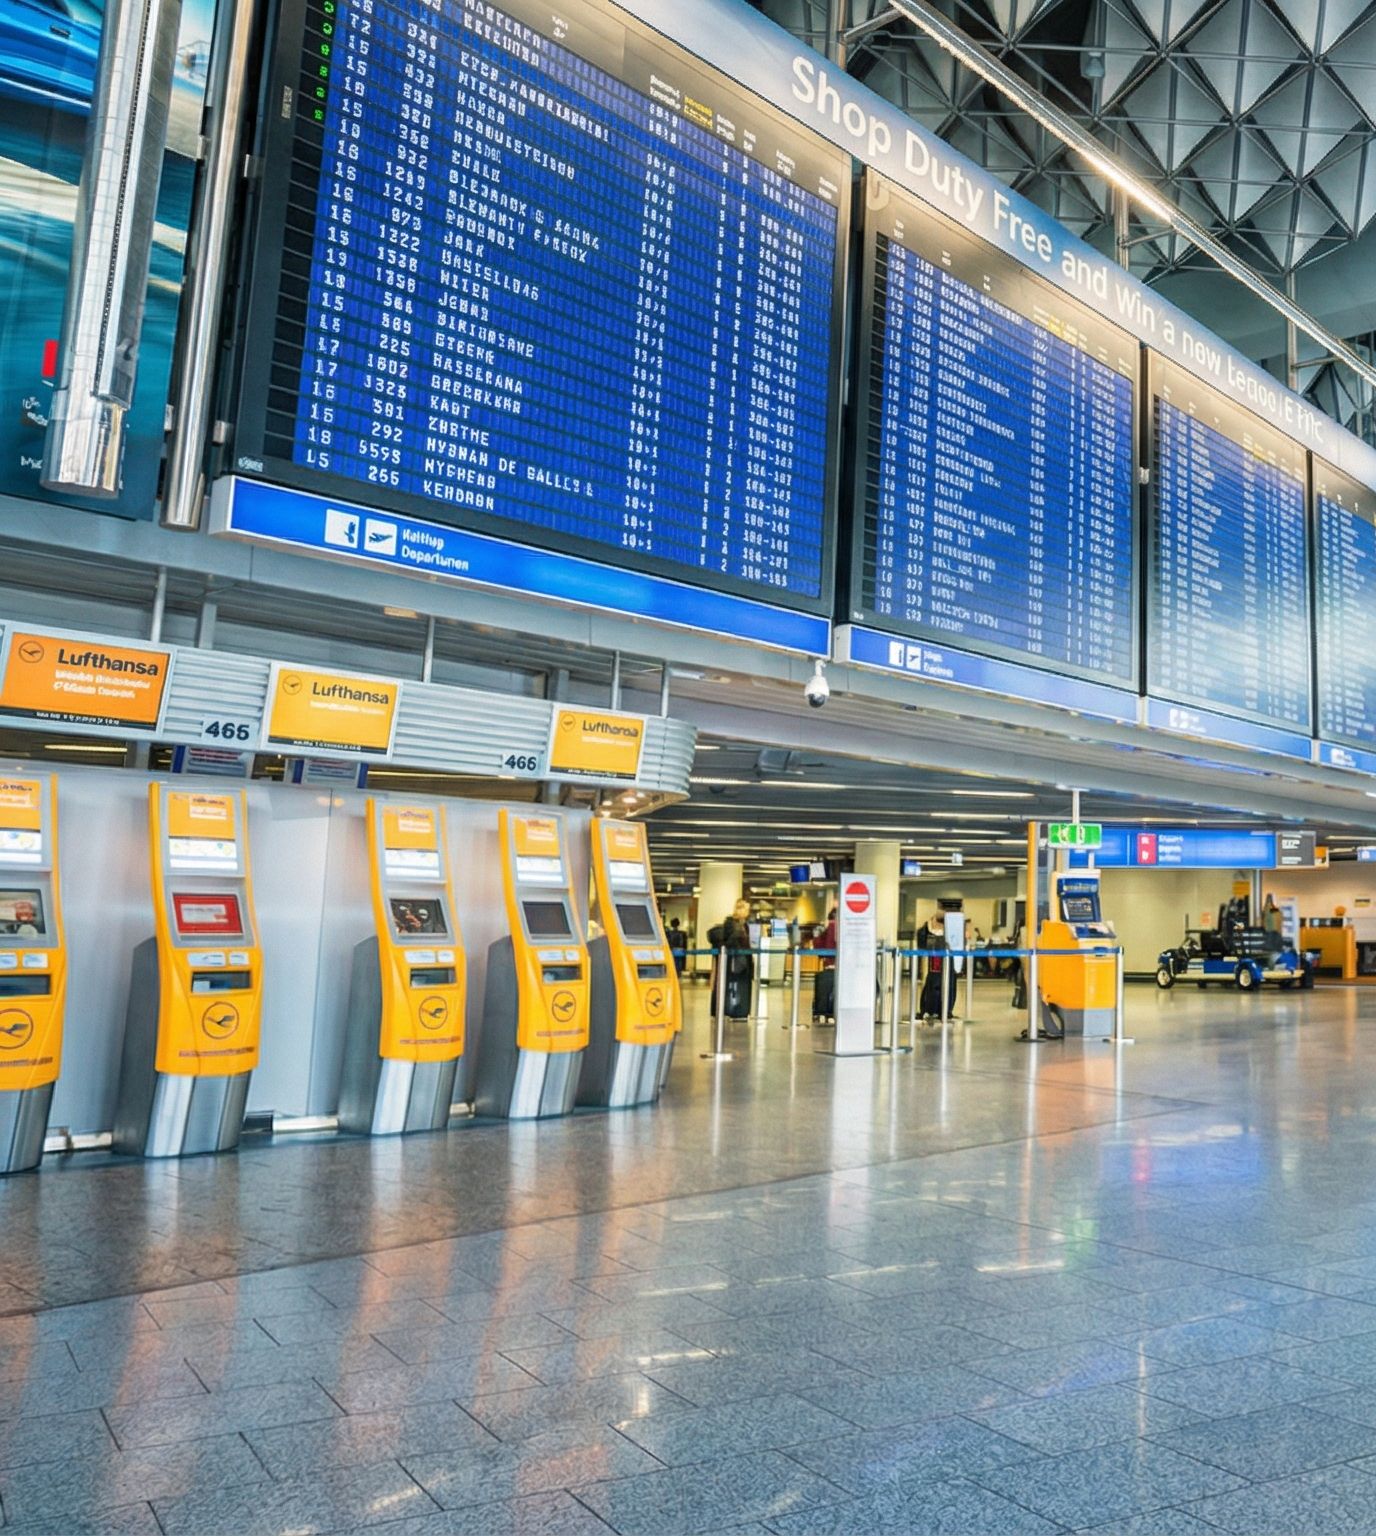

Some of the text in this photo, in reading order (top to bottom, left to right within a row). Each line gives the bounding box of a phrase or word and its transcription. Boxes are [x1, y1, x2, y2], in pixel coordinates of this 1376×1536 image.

[791, 56, 892, 157] Shop
[905, 129, 985, 221] Duty
[993, 189, 1054, 262] Free
[1062, 249, 1108, 300] and
[1163, 320, 1175, 346] a
[371, 421, 403, 443] 292
[498, 458, 517, 475] DE
[58, 648, 159, 676] Lufthansa
[312, 682, 389, 705] Lufthansa
